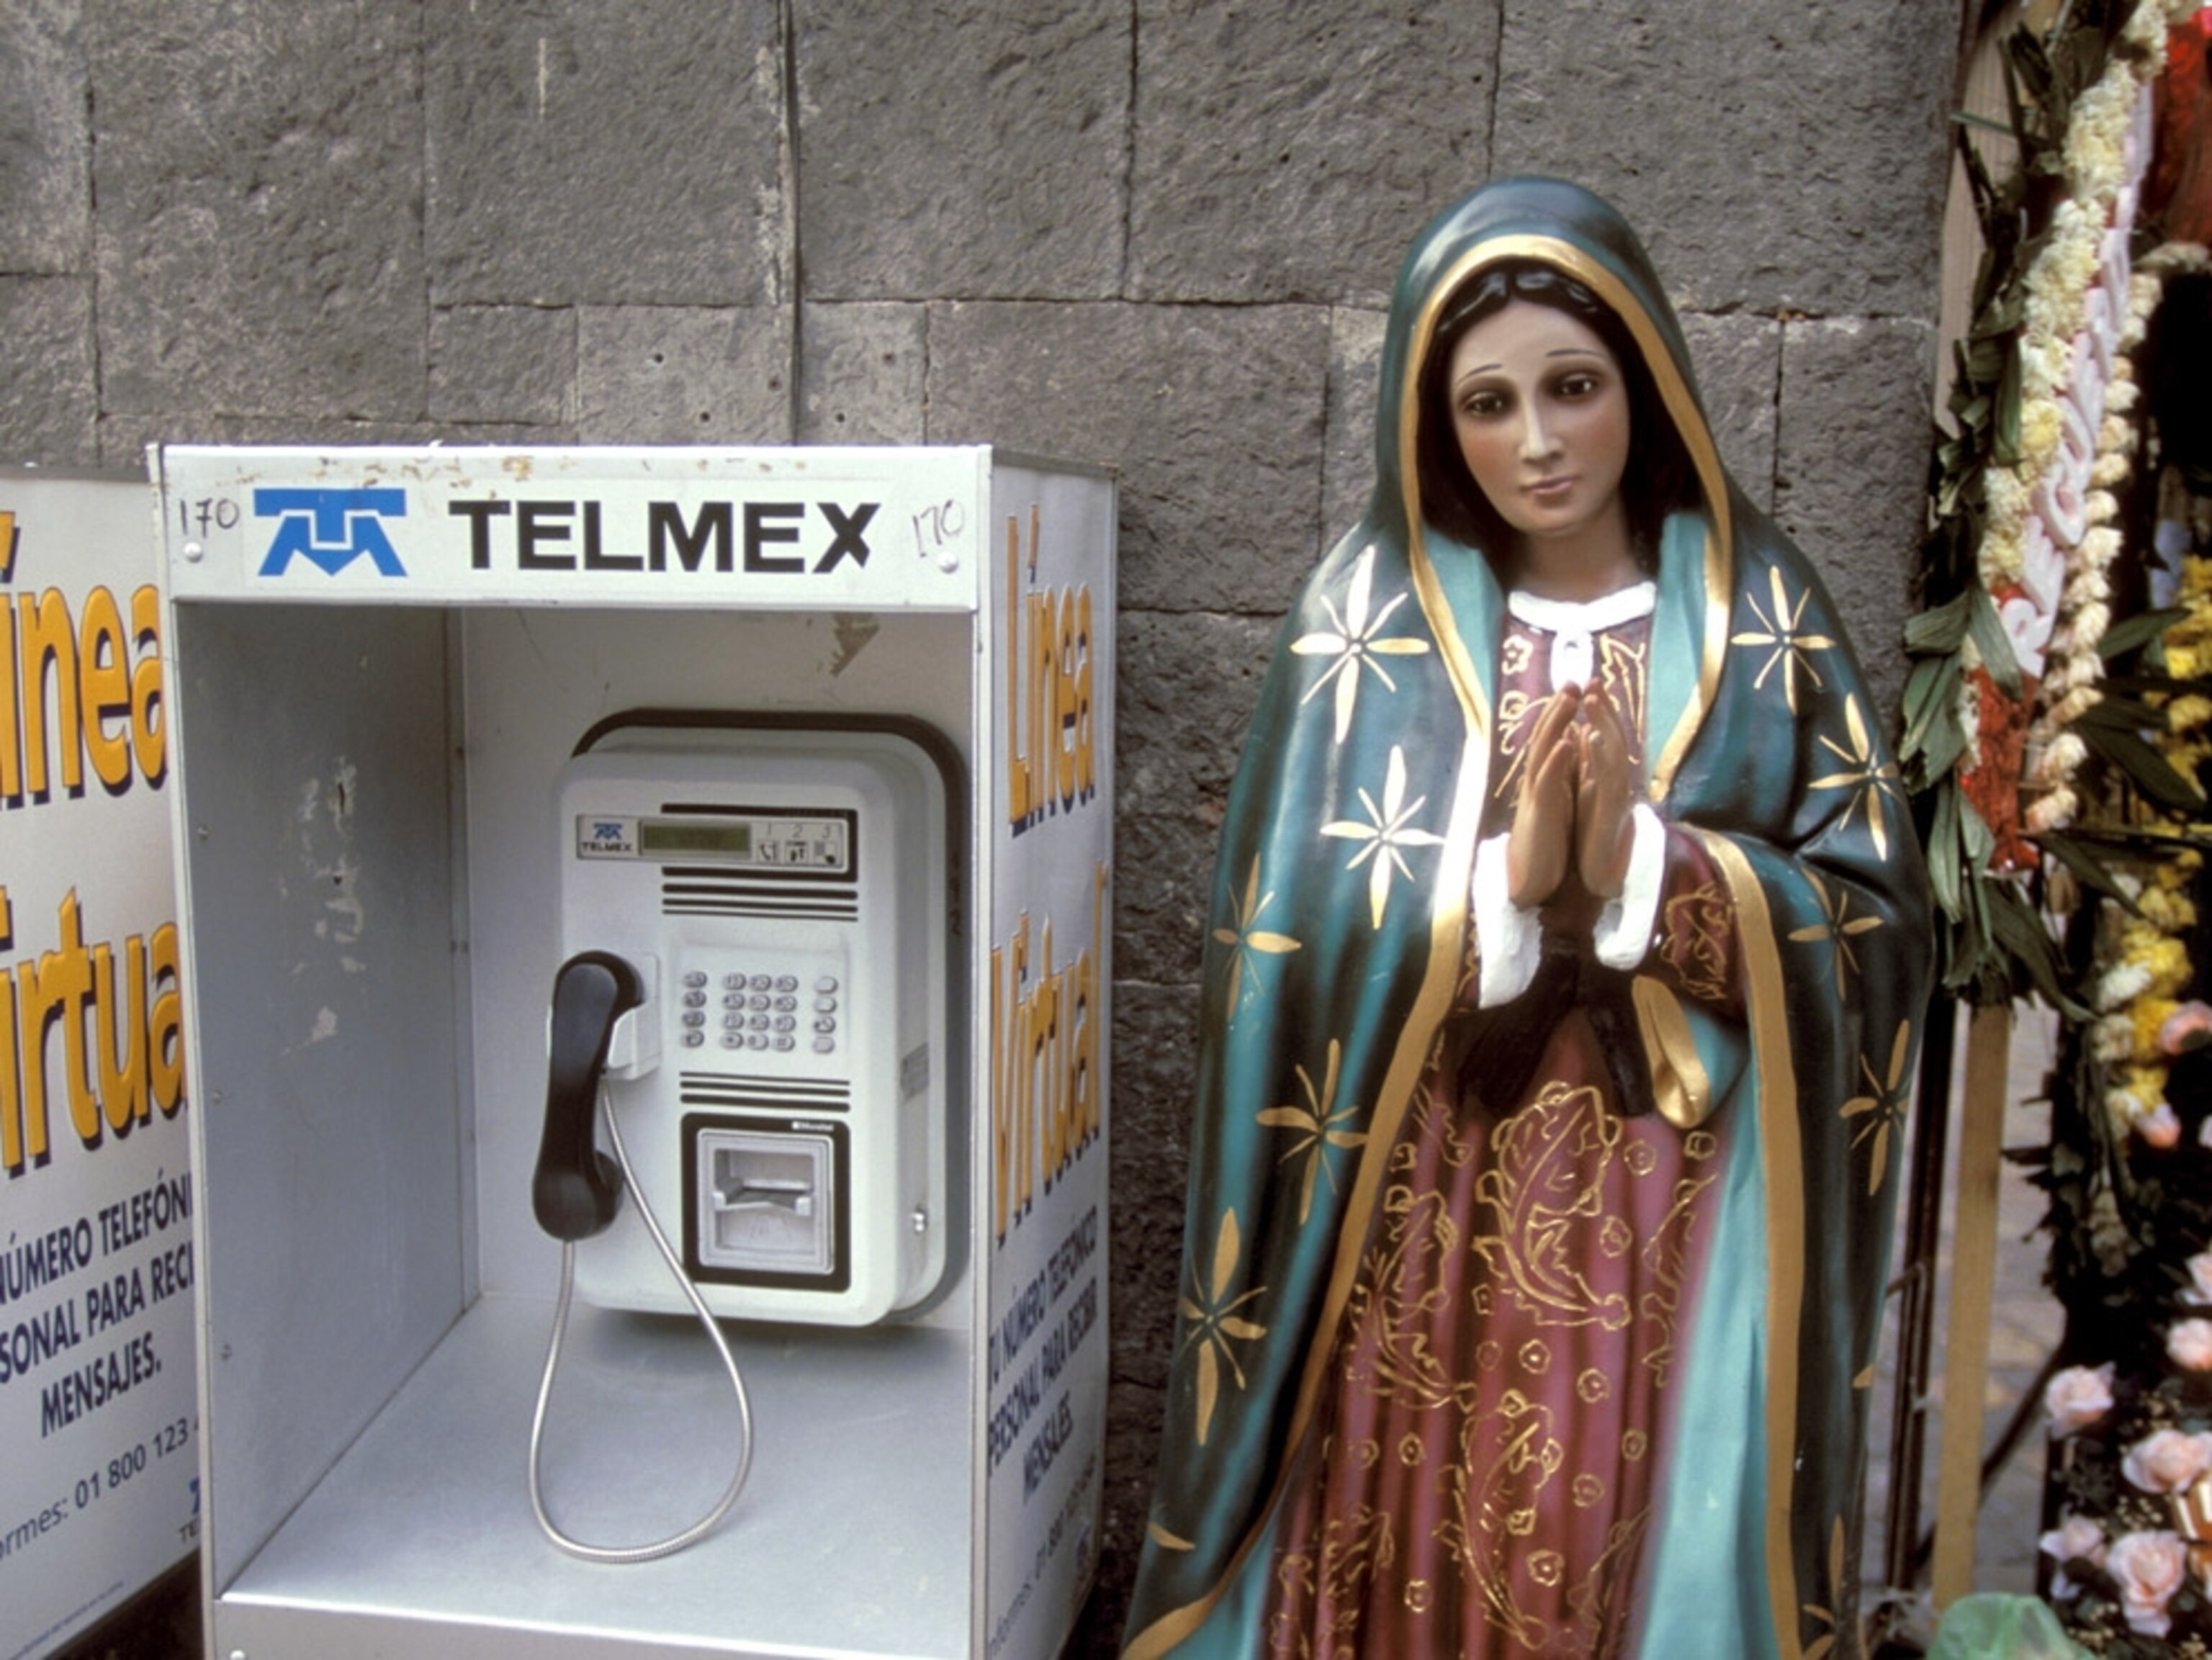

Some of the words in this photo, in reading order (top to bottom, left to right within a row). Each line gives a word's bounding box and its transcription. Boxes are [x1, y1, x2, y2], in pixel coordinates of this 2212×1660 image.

[179, 498, 240, 538] 170
[449, 500, 881, 574] TELMEX
[1007, 504, 1095, 839] Línea
[581, 842, 632, 853] TELMEX
[992, 860, 1107, 1250] Virtual
[86, 1267, 145, 1337] PARA
[42, 1331, 162, 1438] MENSAJES.
[75, 1472, 99, 1510] 01
[108, 1443, 147, 1489] 800
[153, 1417, 189, 1459] 123
